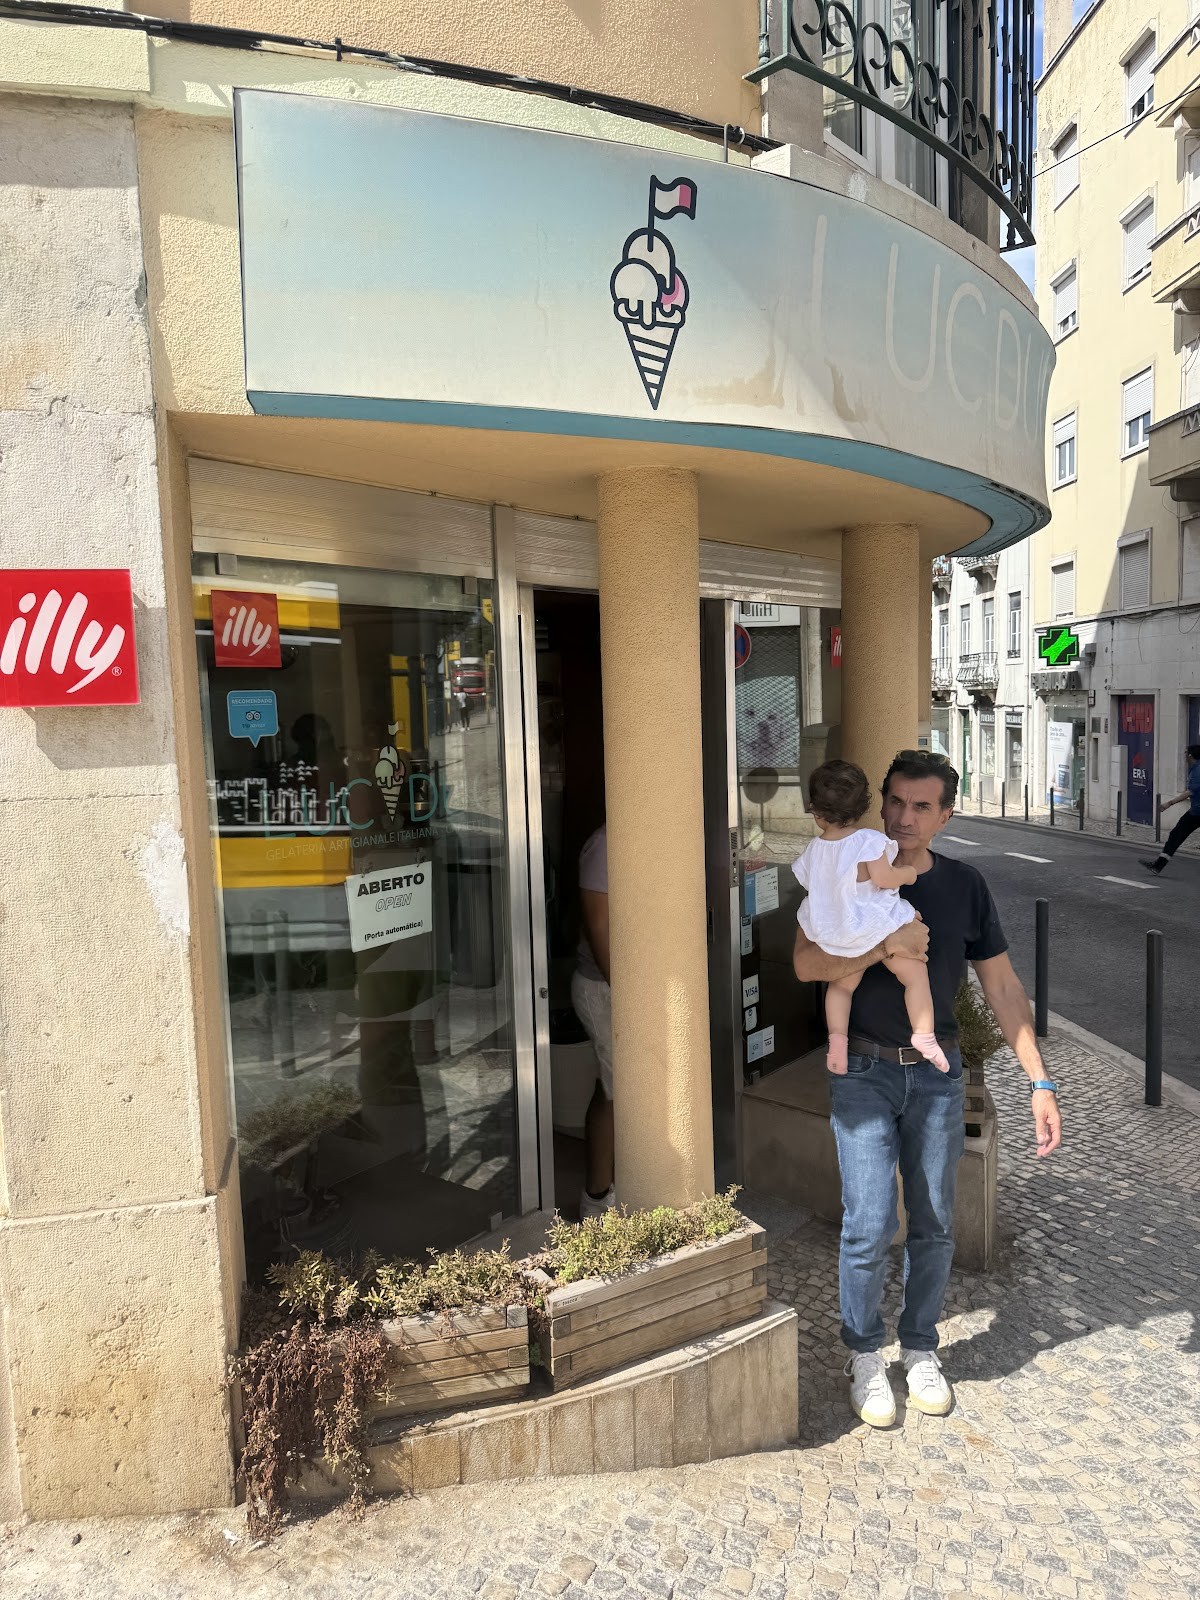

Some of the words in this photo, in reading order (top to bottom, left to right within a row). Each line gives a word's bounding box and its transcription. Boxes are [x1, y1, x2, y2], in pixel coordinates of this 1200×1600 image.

[0, 589, 125, 693] illy
[222, 605, 272, 656] illy
[265, 842, 327, 861] GELATERIA
[329, 831, 395, 853] ARTIGIANALE
[397, 826, 439, 842] ITALIANA
[357, 872, 425, 897] ABERTO
[375, 892, 413, 912] OPEN
[364, 932, 384, 942] (Porta
[745, 985, 758, 998] VISA
